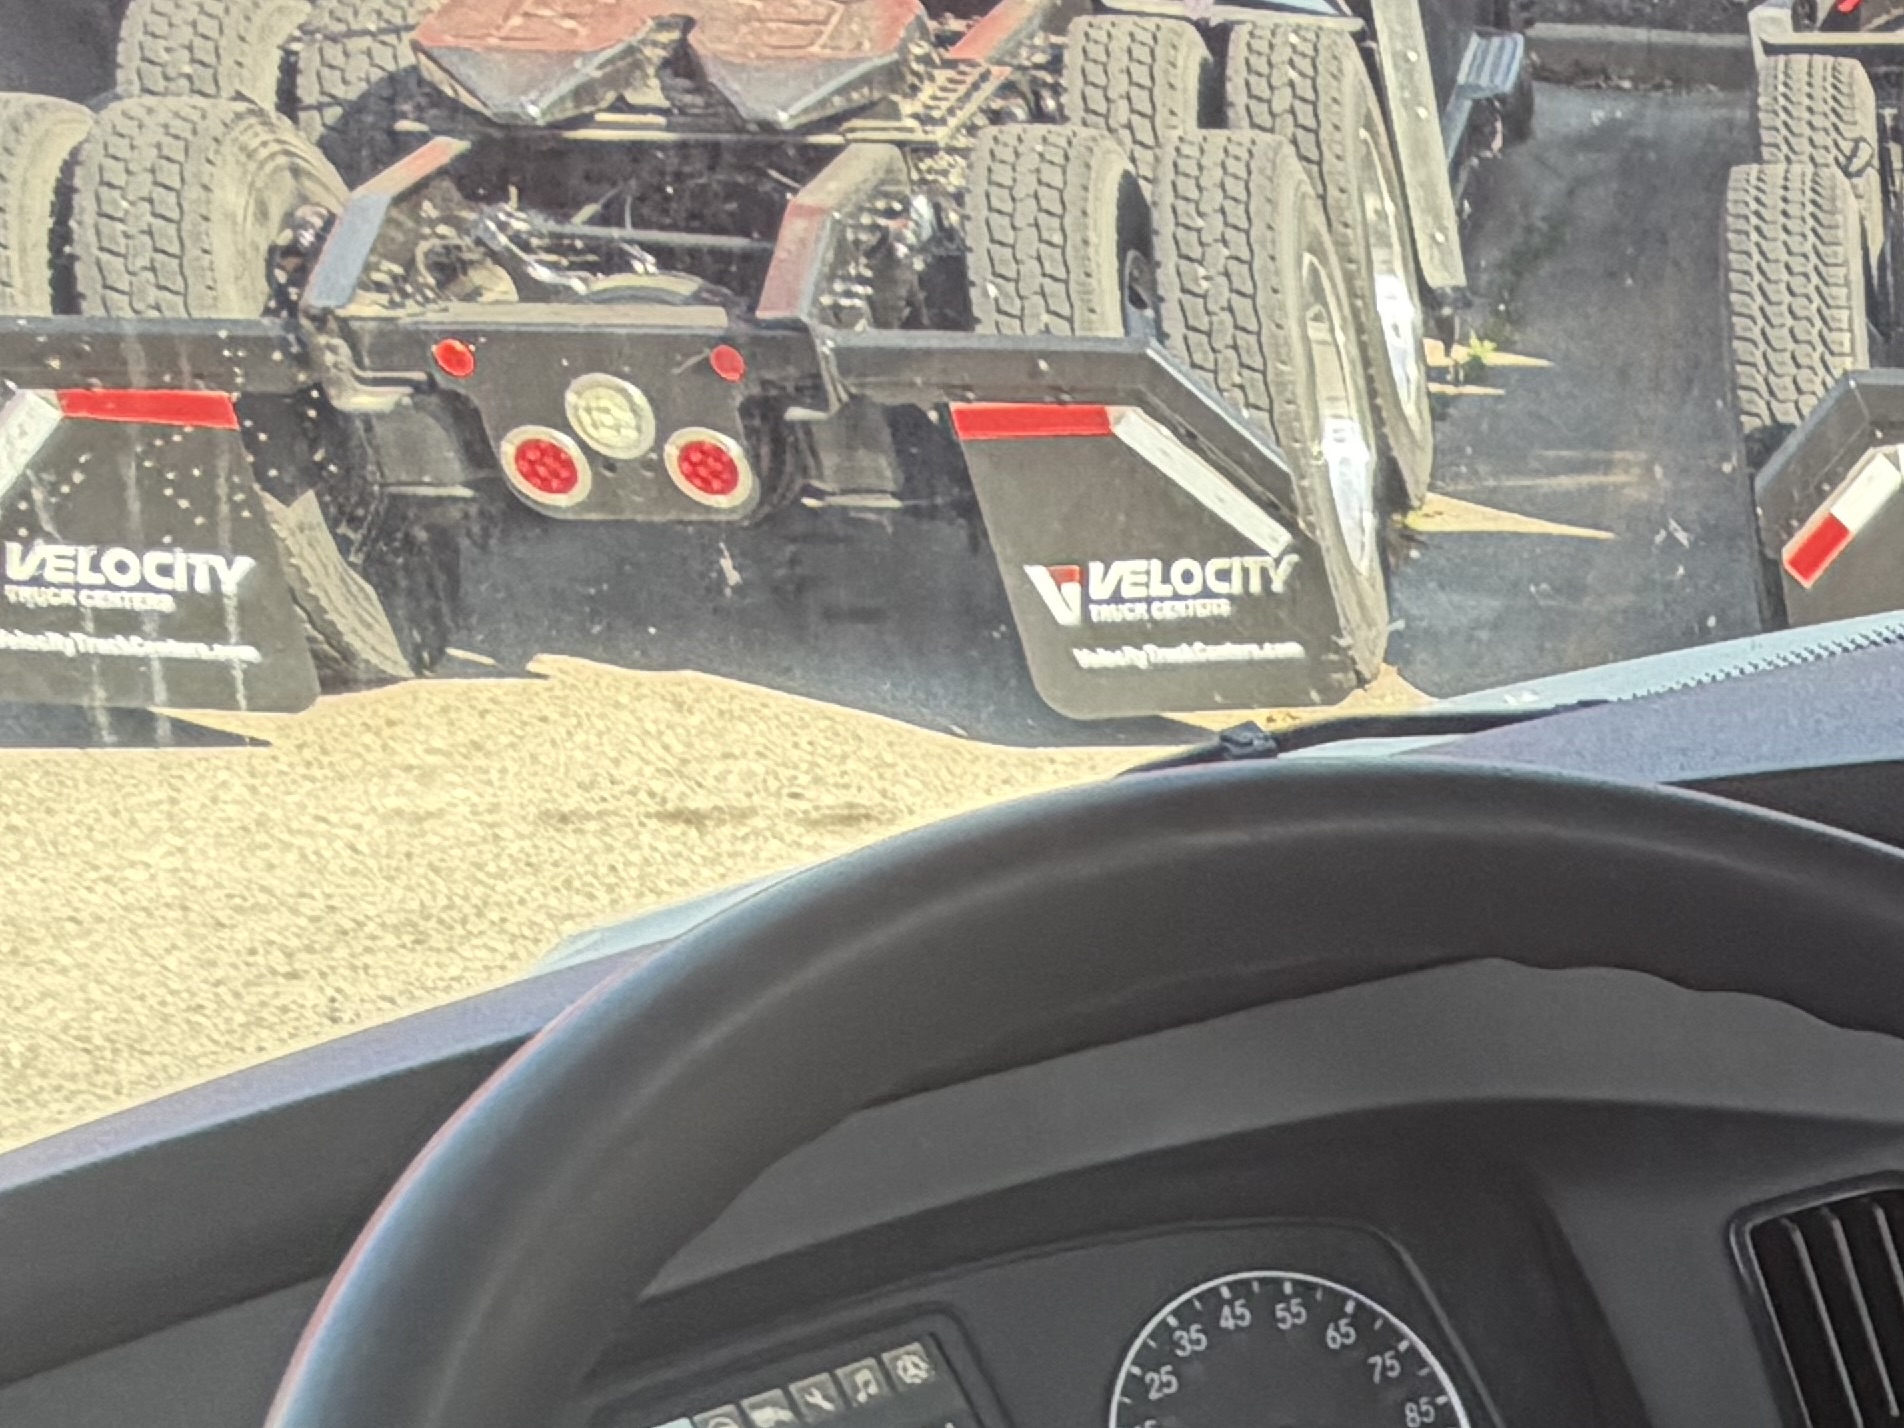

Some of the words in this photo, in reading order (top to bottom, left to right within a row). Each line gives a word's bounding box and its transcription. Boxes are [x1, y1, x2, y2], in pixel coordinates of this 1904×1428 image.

[4, 540, 256, 594] VELOCITY
[1088, 553, 1300, 600] VELOCITY
[1219, 1299, 1251, 1331] 45
[1275, 1299, 1308, 1330] 55
[1173, 1324, 1208, 1358] 35
[1326, 1318, 1357, 1350] 65
[1145, 1364, 1179, 1400] 25
[1367, 1350, 1401, 1384] 75
[1404, 1397, 1436, 1428] 85
